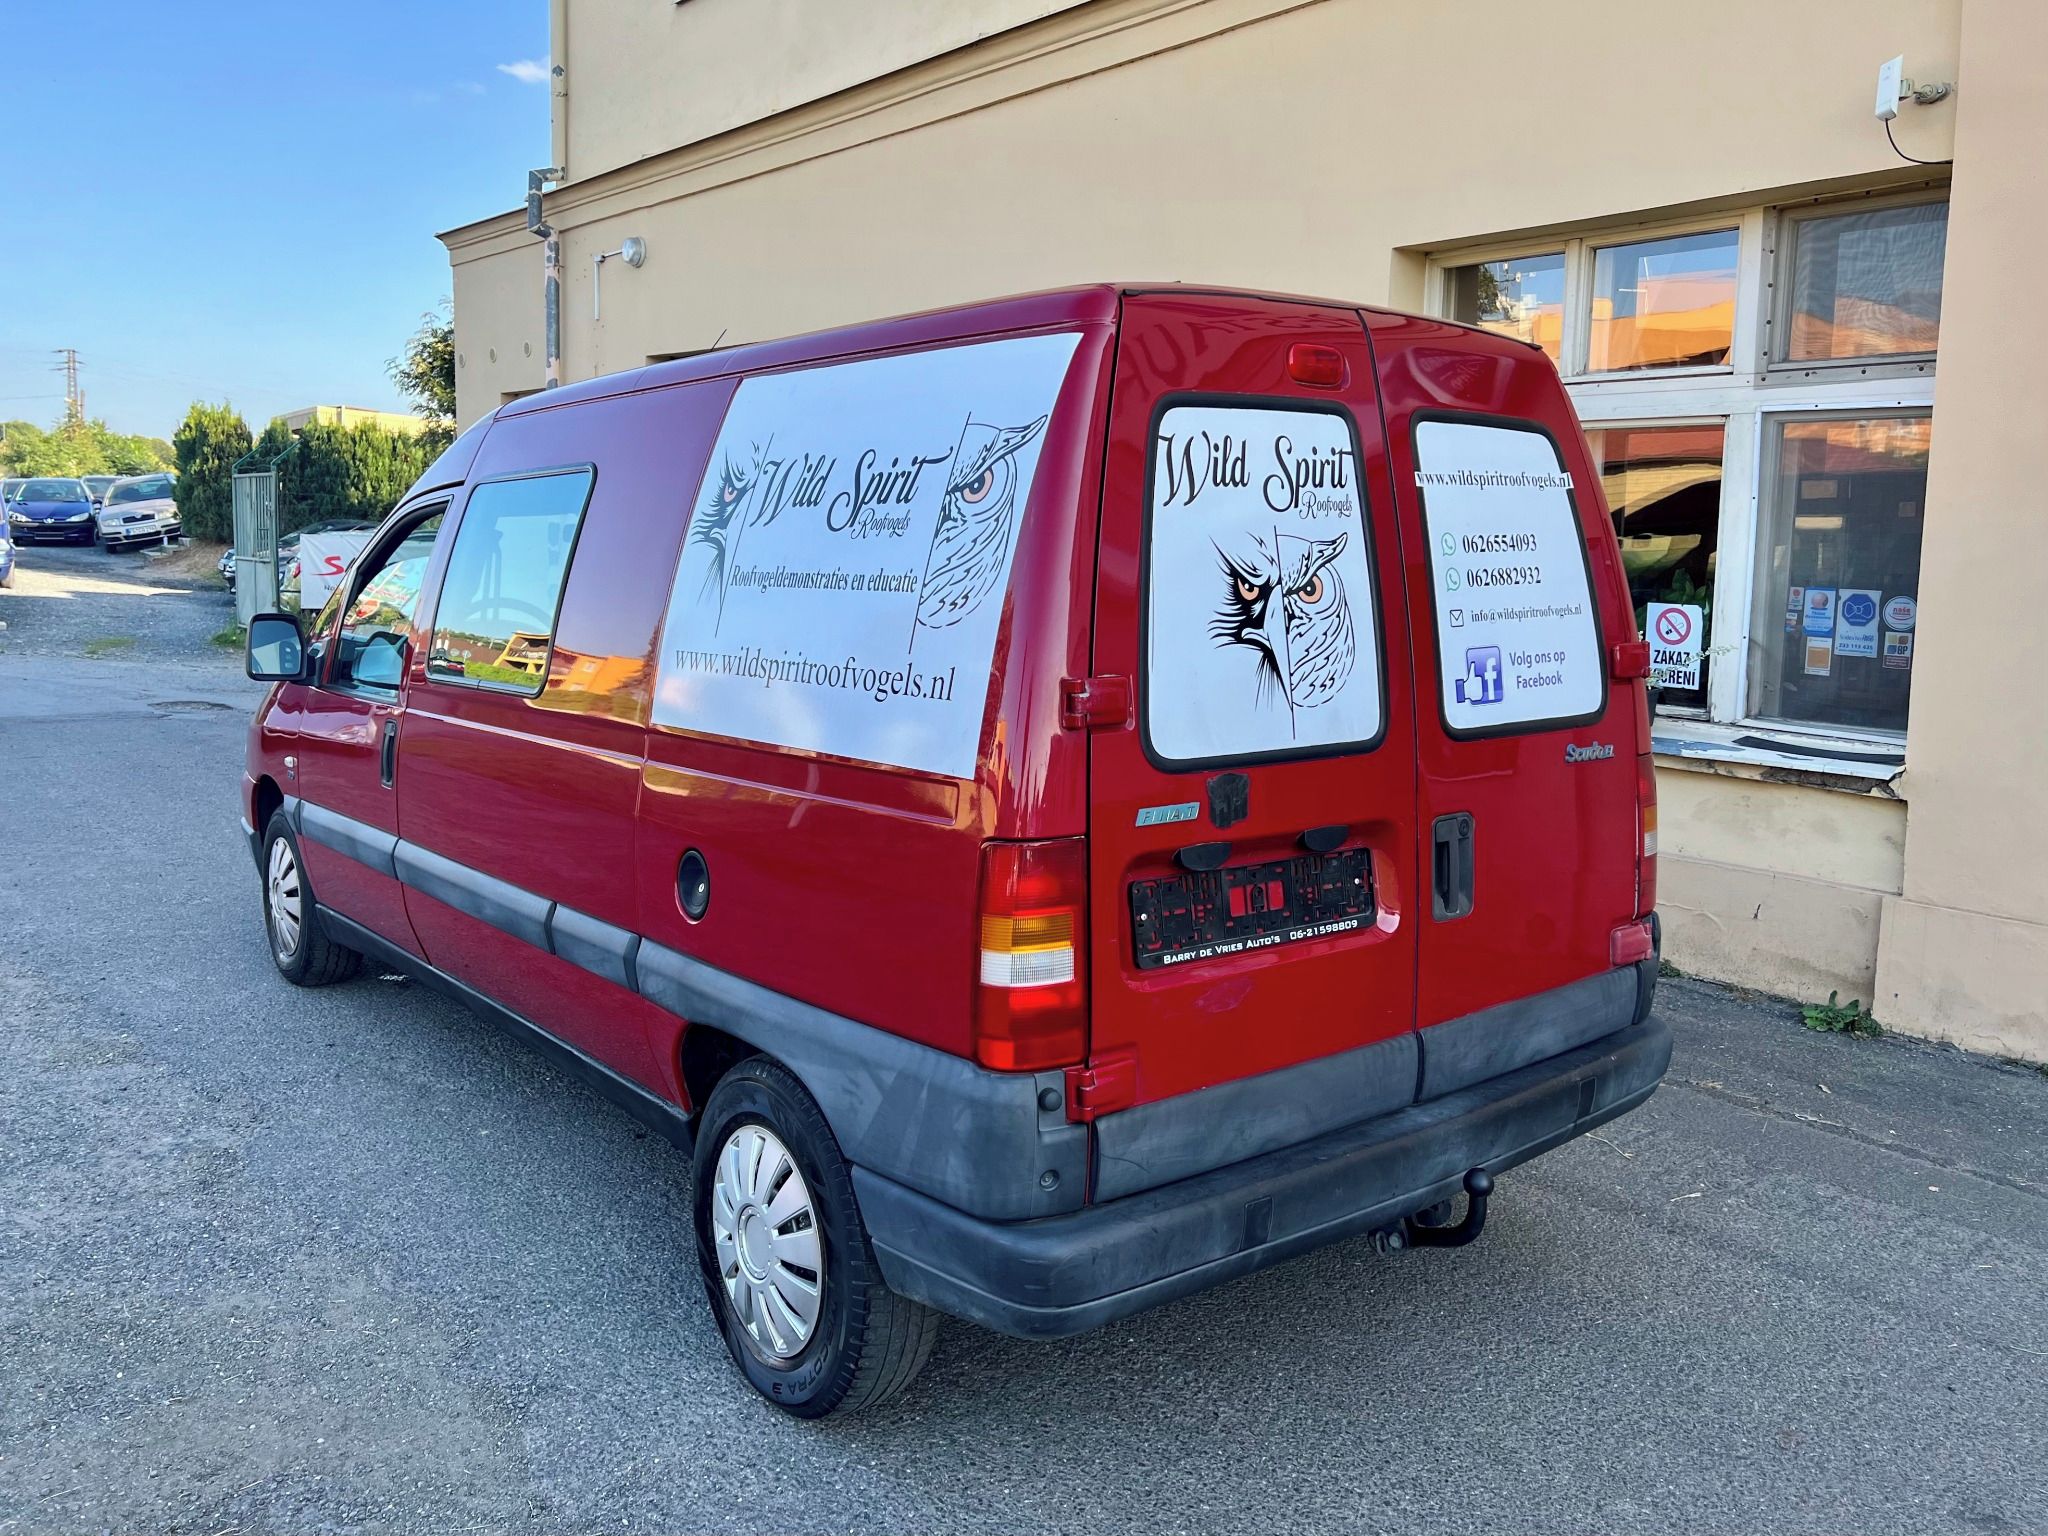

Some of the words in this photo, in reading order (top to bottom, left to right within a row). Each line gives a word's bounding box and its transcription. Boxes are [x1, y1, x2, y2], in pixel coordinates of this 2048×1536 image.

[1158, 430, 1250, 507] Wild
[1263, 435, 1352, 512] Spirit
[1417, 469, 1571, 491] www.wildspiritroofvogels.nl
[749, 452, 838, 528] Wild
[826, 446, 954, 532] Spirit
[1299, 490, 1353, 519] Roofvogels
[850, 507, 911, 540] Roofvogels
[1462, 534, 1537, 553] 0626554093
[730, 564, 849, 594] Roofvogeldemonstraties
[851, 574, 866, 591] en
[867, 567, 918, 593] educatie
[1467, 567, 1542, 587] 0626882932
[1471, 604, 1582, 624] info@wildspiritroofvogels.nl
[1509, 650, 1532, 668] Volg
[1535, 652, 1551, 664] ons
[1554, 650, 1566, 664] op
[1653, 647, 1690, 666] ZÁKAZ
[675, 645, 956, 702] www.wildspiritroofvogels.nl
[1516, 670, 1563, 689] Facebook
[1142, 805, 1196, 824] FIAT
[1163, 952, 1197, 964] BARRY
[1215, 942, 1243, 954] VRIES
[1290, 919, 1358, 940] 06-21598809
